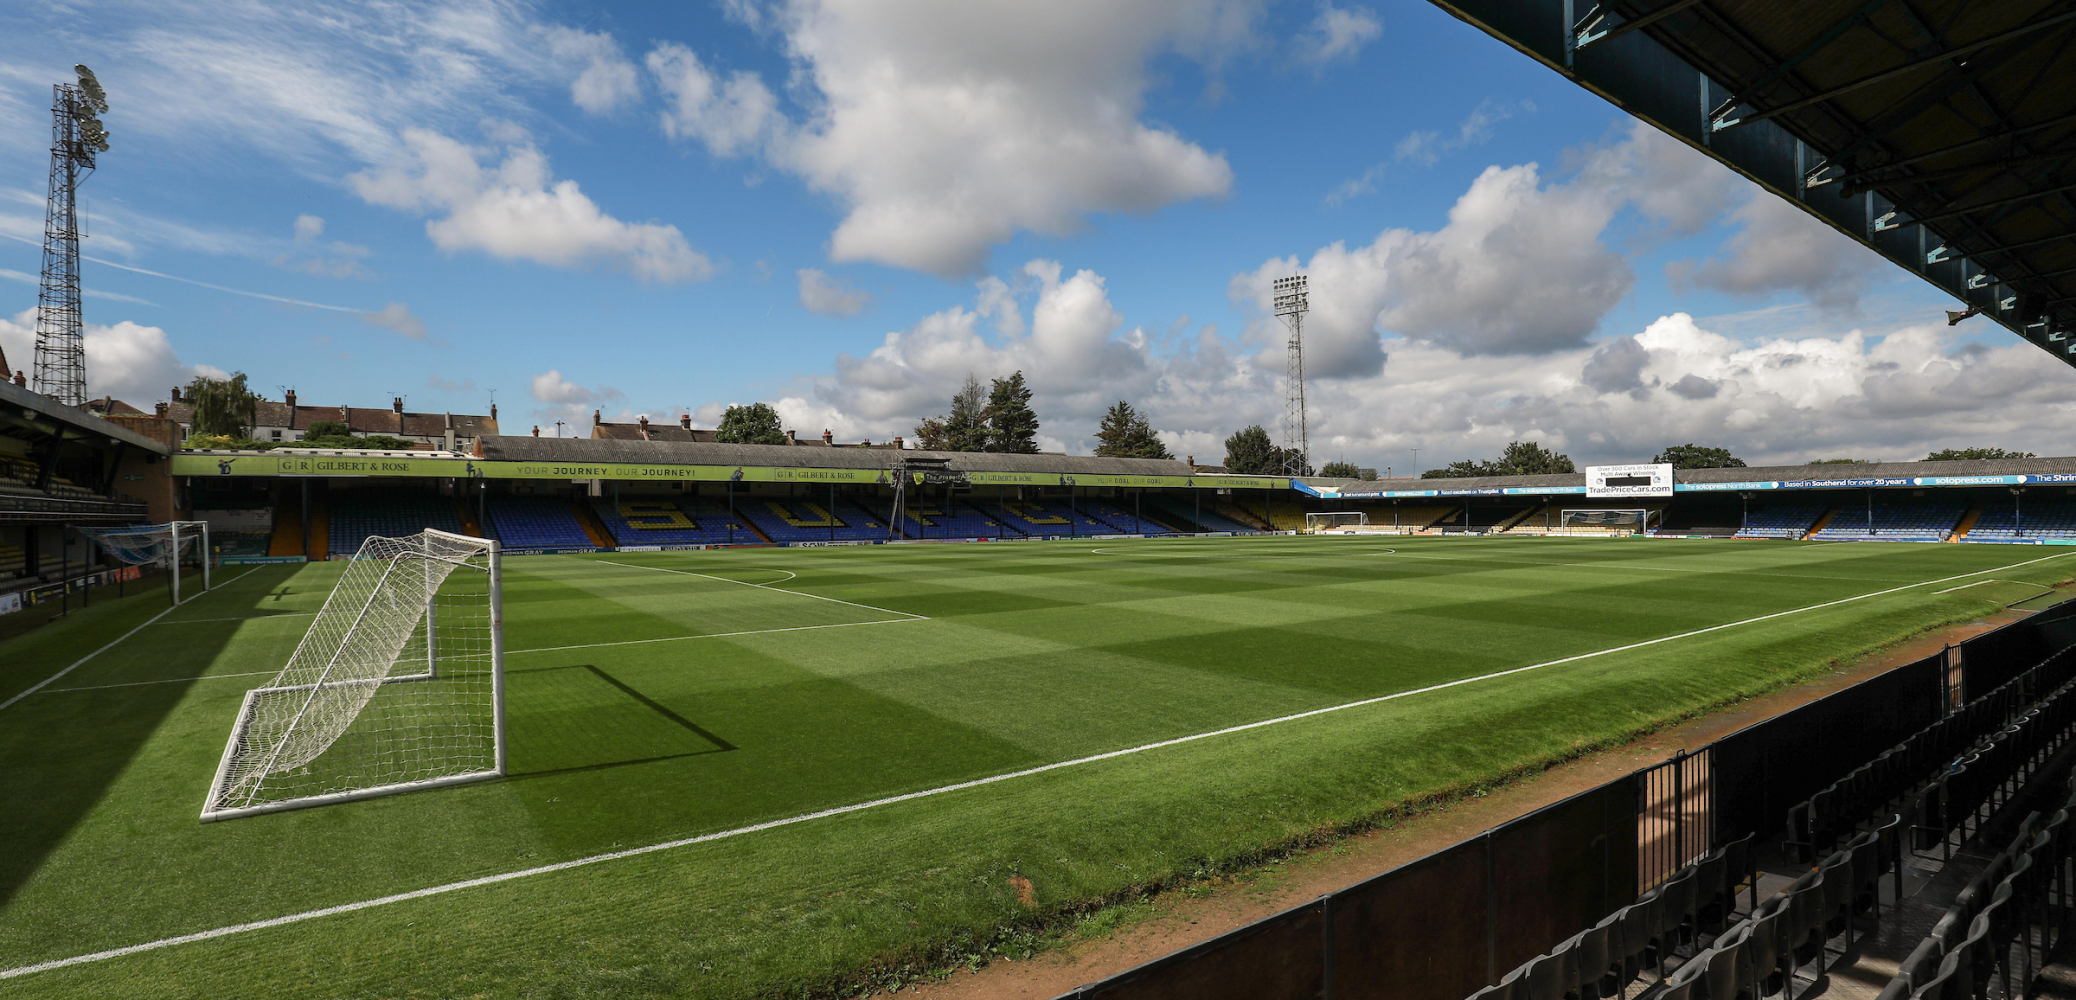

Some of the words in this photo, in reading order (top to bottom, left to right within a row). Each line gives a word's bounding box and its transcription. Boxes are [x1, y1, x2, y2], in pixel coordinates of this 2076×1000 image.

[282, 461, 292, 470] G
[300, 462, 309, 470] R
[317, 462, 368, 471] GILBERT
[370, 462, 378, 471] &
[382, 463, 410, 471] ROSE
[517, 466, 548, 475] YOUR
[616, 468, 638, 476] OUR
[642, 468, 695, 477] JOURNEY!
[798, 471, 828, 479] GILBERT
[1935, 476, 2003, 485] solopress.com
[1588, 485, 1671, 494] TradePriceCars.com
[1696, 483, 1727, 491] solopress
